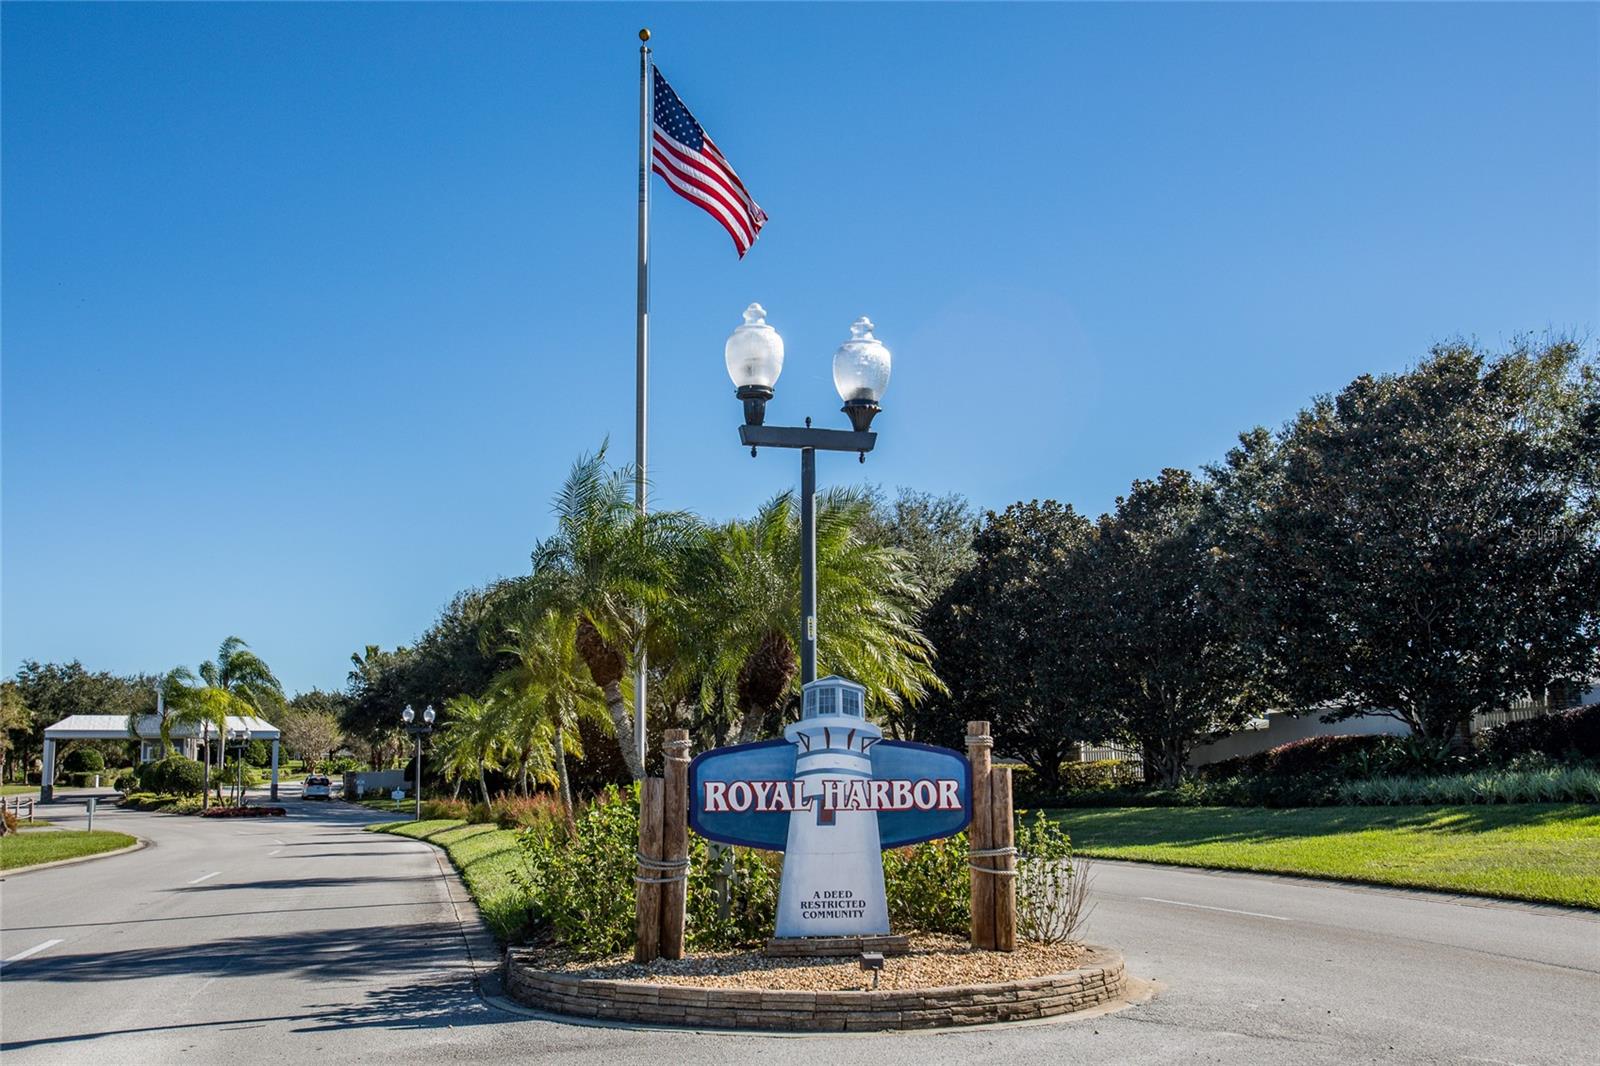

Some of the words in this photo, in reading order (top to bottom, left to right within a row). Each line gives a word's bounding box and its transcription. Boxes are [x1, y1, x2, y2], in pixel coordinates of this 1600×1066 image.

[703, 780, 813, 812] ROYAL
[822, 779, 963, 811] HARBOR
[813, 891, 821, 899] A
[824, 890, 853, 899] DEED
[800, 900, 866, 909] RESTRICTED
[802, 910, 865, 919] COMMUNITY
